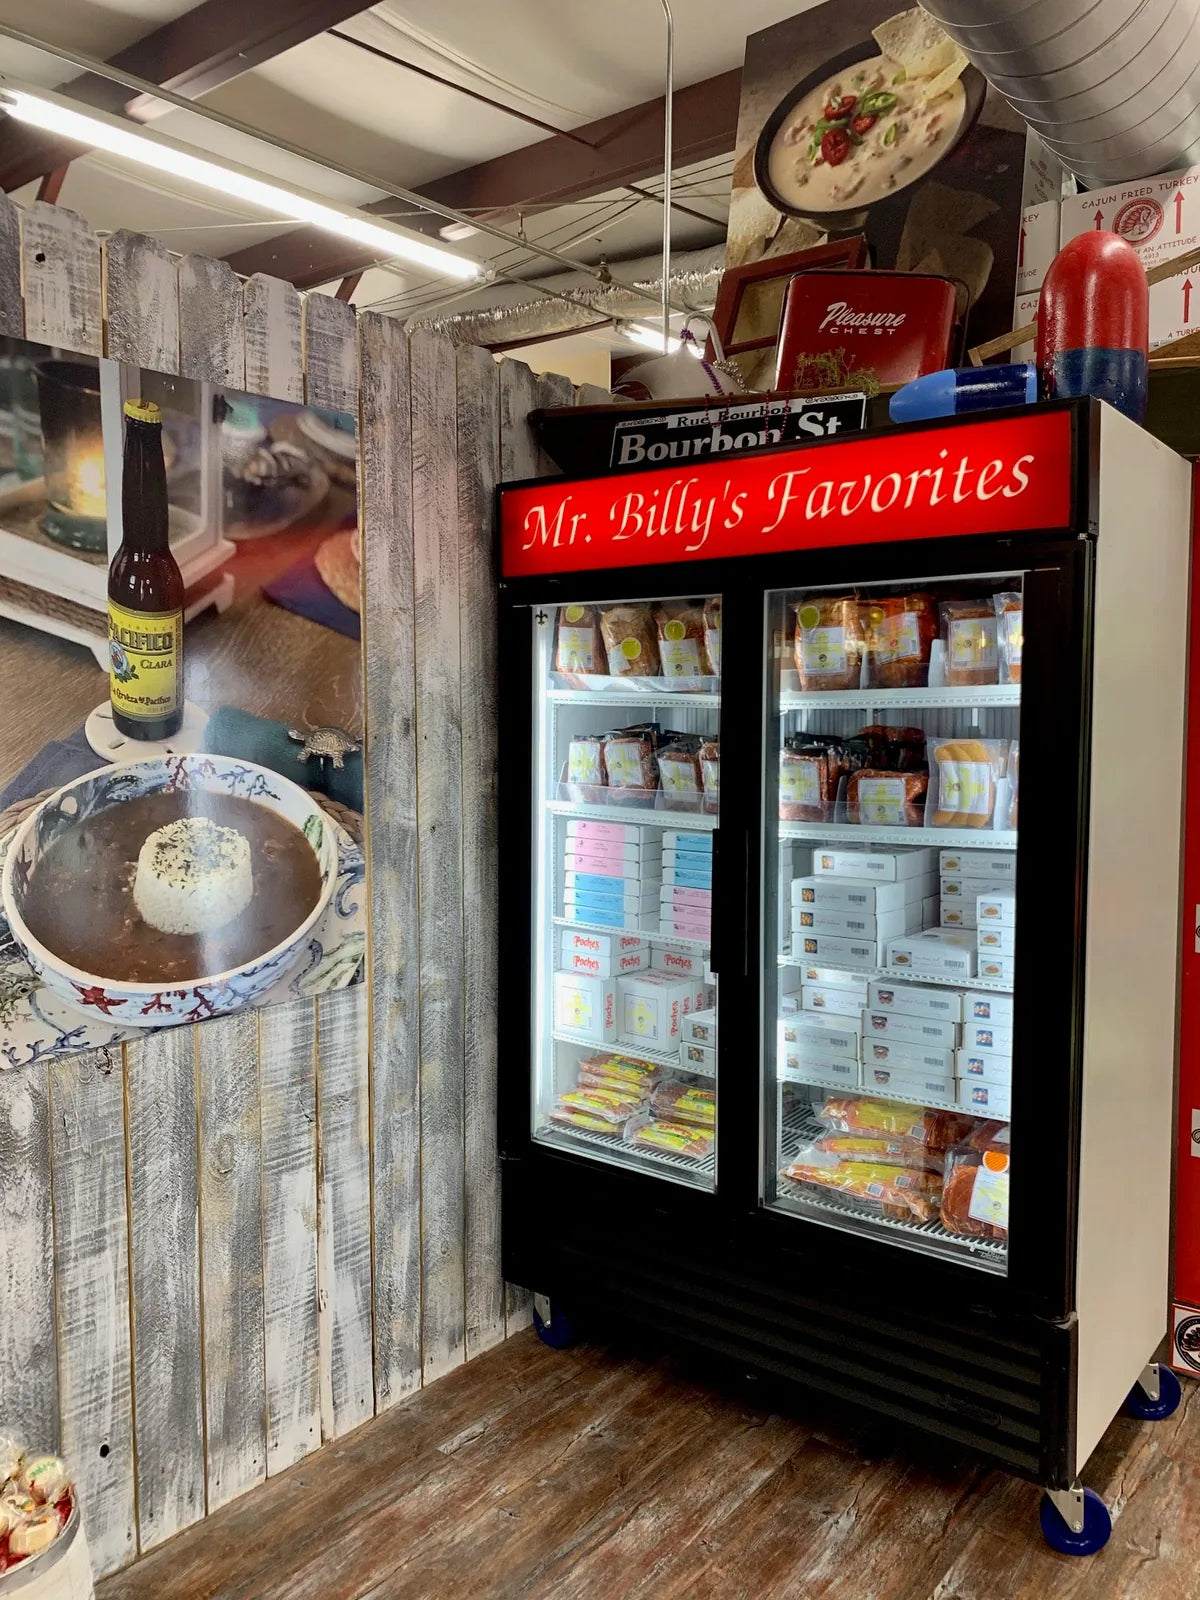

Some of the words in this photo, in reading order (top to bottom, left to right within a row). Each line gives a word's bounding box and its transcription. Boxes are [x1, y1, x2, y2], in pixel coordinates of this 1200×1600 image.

[1081, 194, 1117, 210] CAJUN
[1121, 186, 1153, 200] FRIED
[1159, 175, 1199, 191] TURKEY
[1022, 212, 1040, 223] KEY
[1143, 246, 1154, 254] AN
[1157, 236, 1197, 250] ATTITUDE
[1020, 299, 1038, 310] CAJ
[819, 301, 907, 330] Pleasure
[829, 327, 896, 335] CHEST
[677, 415, 710, 427] Rue
[717, 404, 792, 421] Bourbon
[617, 425, 782, 465] Bourbon
[795, 411, 842, 439] St
[522, 496, 592, 550] Mr.
[609, 478, 748, 552] Billy's
[761, 448, 1035, 533] Favorites
[140, 659, 173, 669] CLARA
